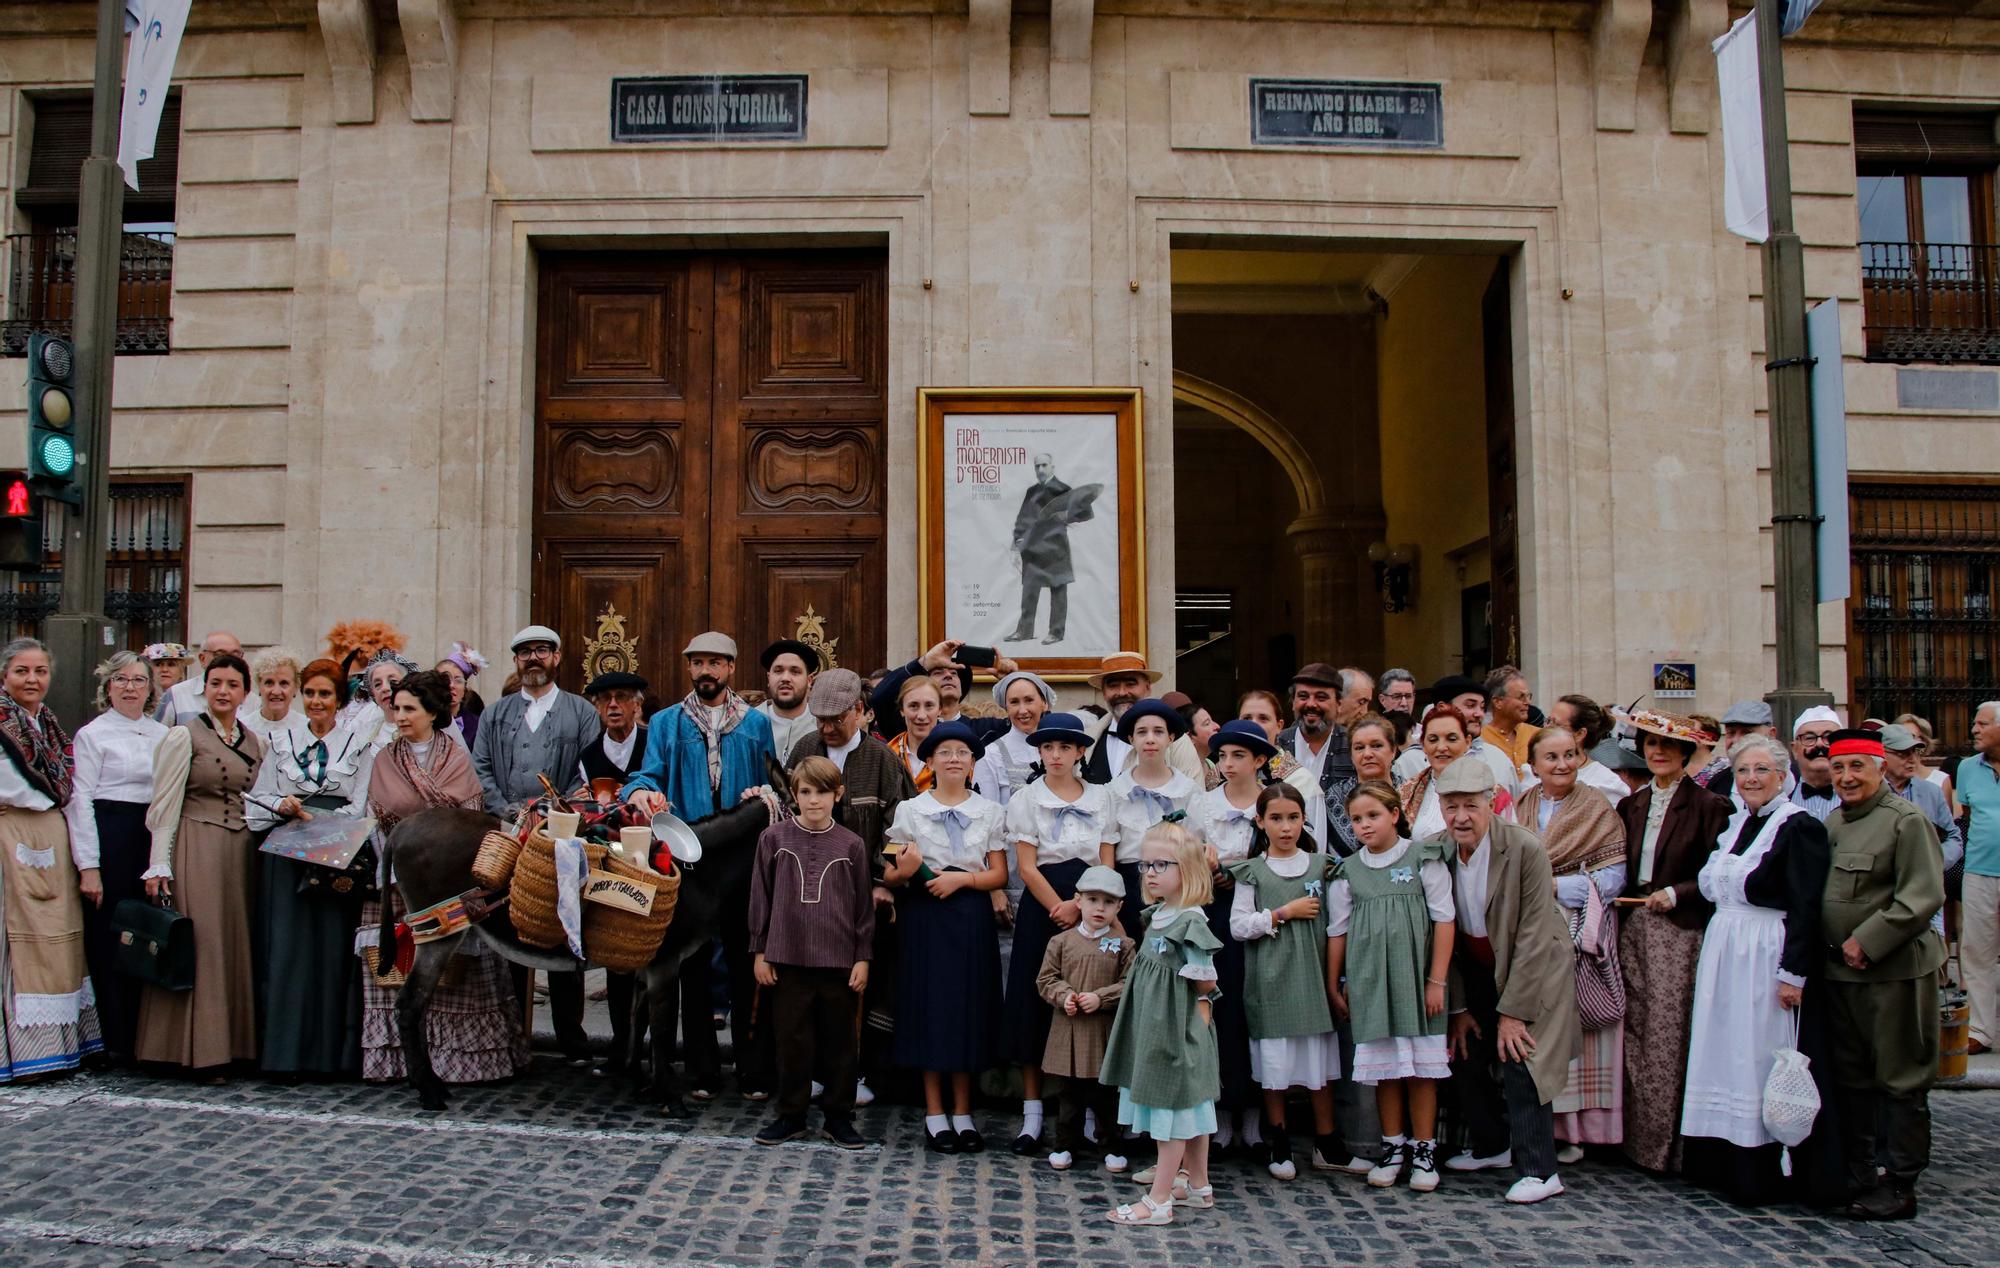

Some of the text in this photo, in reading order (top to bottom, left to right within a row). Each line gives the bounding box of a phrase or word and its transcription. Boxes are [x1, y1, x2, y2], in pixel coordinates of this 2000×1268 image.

[626, 93, 793, 125] CASA CONSISTORIAL.
[1265, 93, 1344, 112] REINANDO
[1349, 95, 1404, 114] ISABEL
[1313, 113, 1343, 133] AÑO
[956, 428, 980, 446] FIRA
[956, 447, 1026, 464] MODERNISTA
[956, 465, 1001, 484] D'ALCOI
